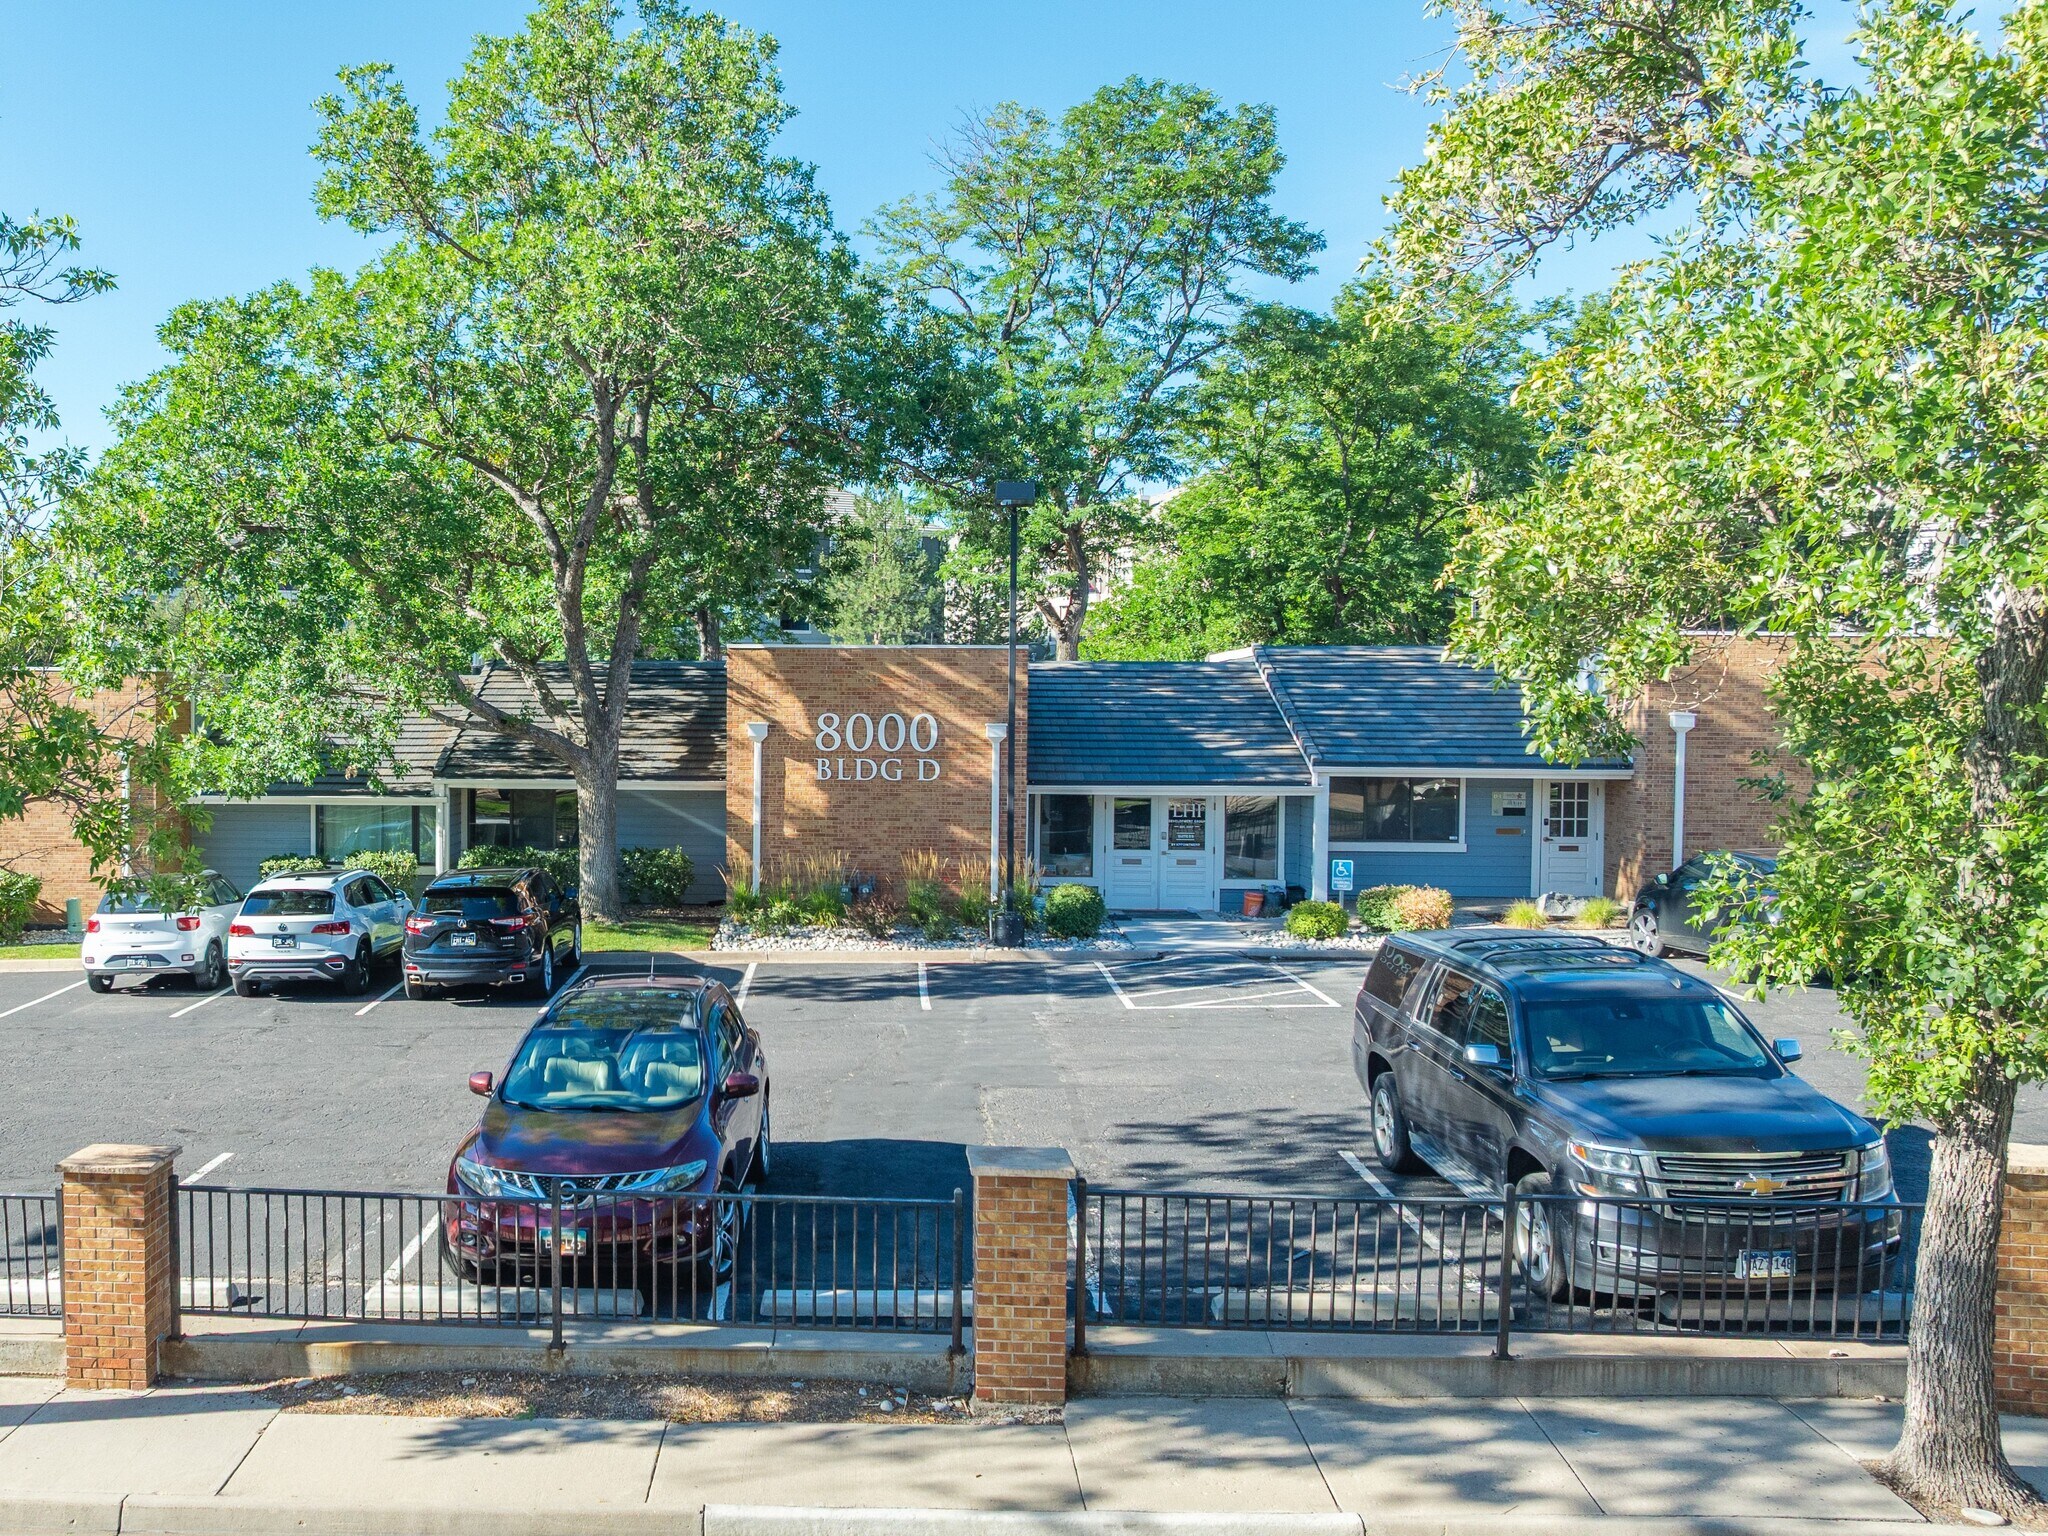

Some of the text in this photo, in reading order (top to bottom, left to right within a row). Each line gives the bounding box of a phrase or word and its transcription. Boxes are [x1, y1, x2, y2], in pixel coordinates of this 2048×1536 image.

[815, 712, 938, 752] 8000
[815, 758, 941, 781] BLDG D
